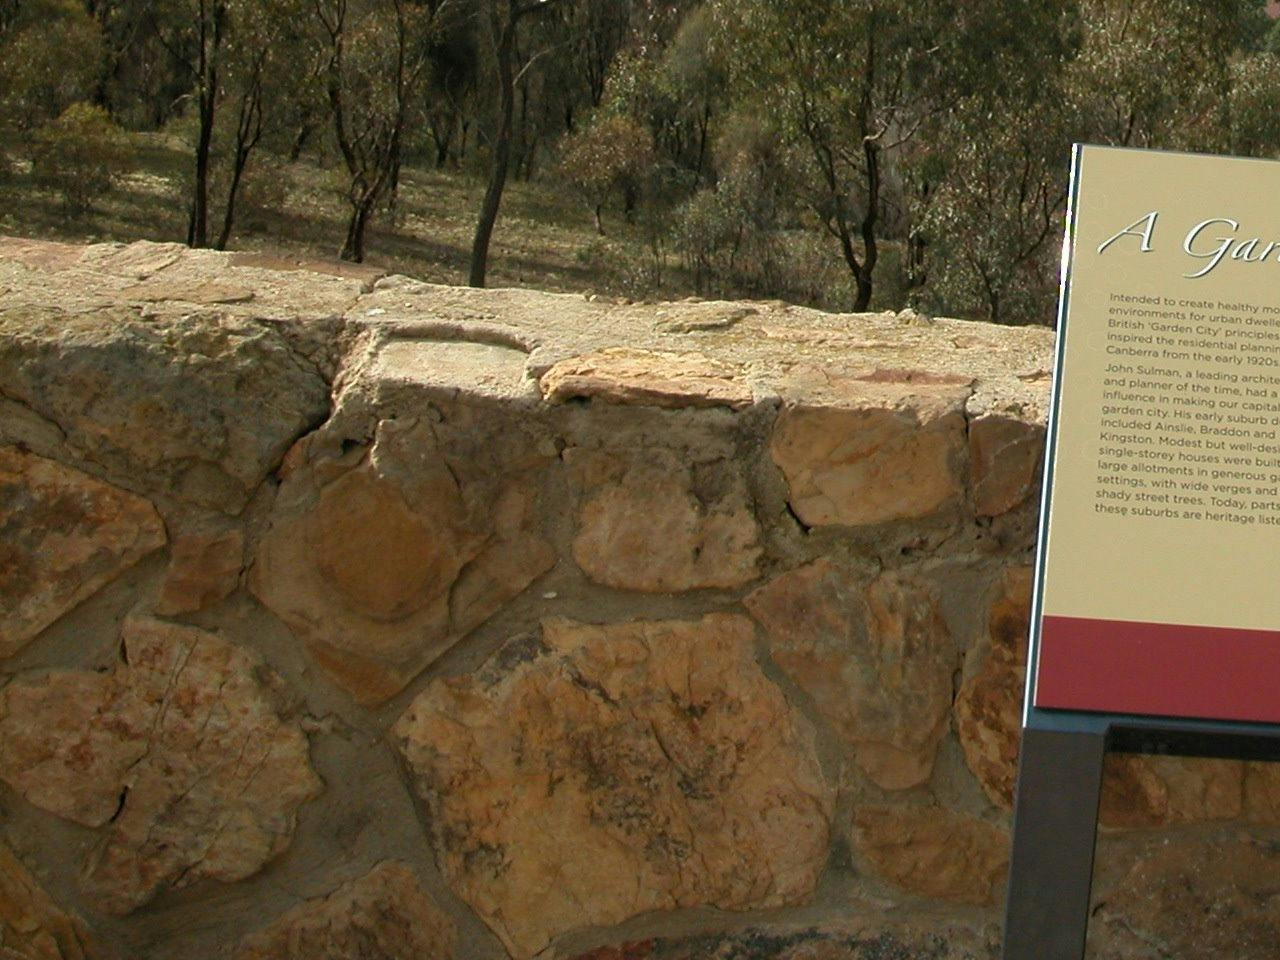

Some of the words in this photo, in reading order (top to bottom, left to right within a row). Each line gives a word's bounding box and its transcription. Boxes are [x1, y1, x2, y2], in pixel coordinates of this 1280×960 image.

[1096, 210, 1158, 254] A
[1110, 292, 1160, 304] Intended
[1163, 297, 1176, 306] to
[1178, 299, 1214, 309] create
[1216, 300, 1259, 314] healthy
[1109, 307, 1186, 320] environments
[1189, 311, 1204, 321] for
[1208, 314, 1242, 324] urban
[1108, 318, 1144, 330] British
[1224, 328, 1280, 341] principles
[1107, 331, 1152, 344] inspired
[1155, 336, 1174, 345] the
[1177, 338, 1237, 350] residential
[1106, 345, 1159, 358] Canberra
[1162, 349, 1190, 360] from
[1192, 352, 1211, 362] the
[1214, 354, 1243, 366] early
[1105, 363, 1133, 374] John
[1195, 370, 1238, 384] leading
[1100, 418, 1151, 430] included
[1199, 425, 1250, 437] Braddon
[1253, 430, 1276, 439] and
[1158, 436, 1201, 448] Modest
[1205, 439, 1225, 449] but
[1098, 446, 1174, 462] single-storey
[1177, 452, 1219, 463] houses
[1223, 457, 1252, 465] were
[1254, 457, 1280, 467] built
[1097, 460, 1128, 472] large
[1130, 462, 1194, 475] allotments
[1196, 467, 1208, 476] in
[1210, 470, 1266, 480] generous
[1095, 503, 1127, 514] these
[1130, 506, 1179, 517] suburbs
[1182, 511, 1201, 519] are
[1204, 511, 1255, 524] heritage
